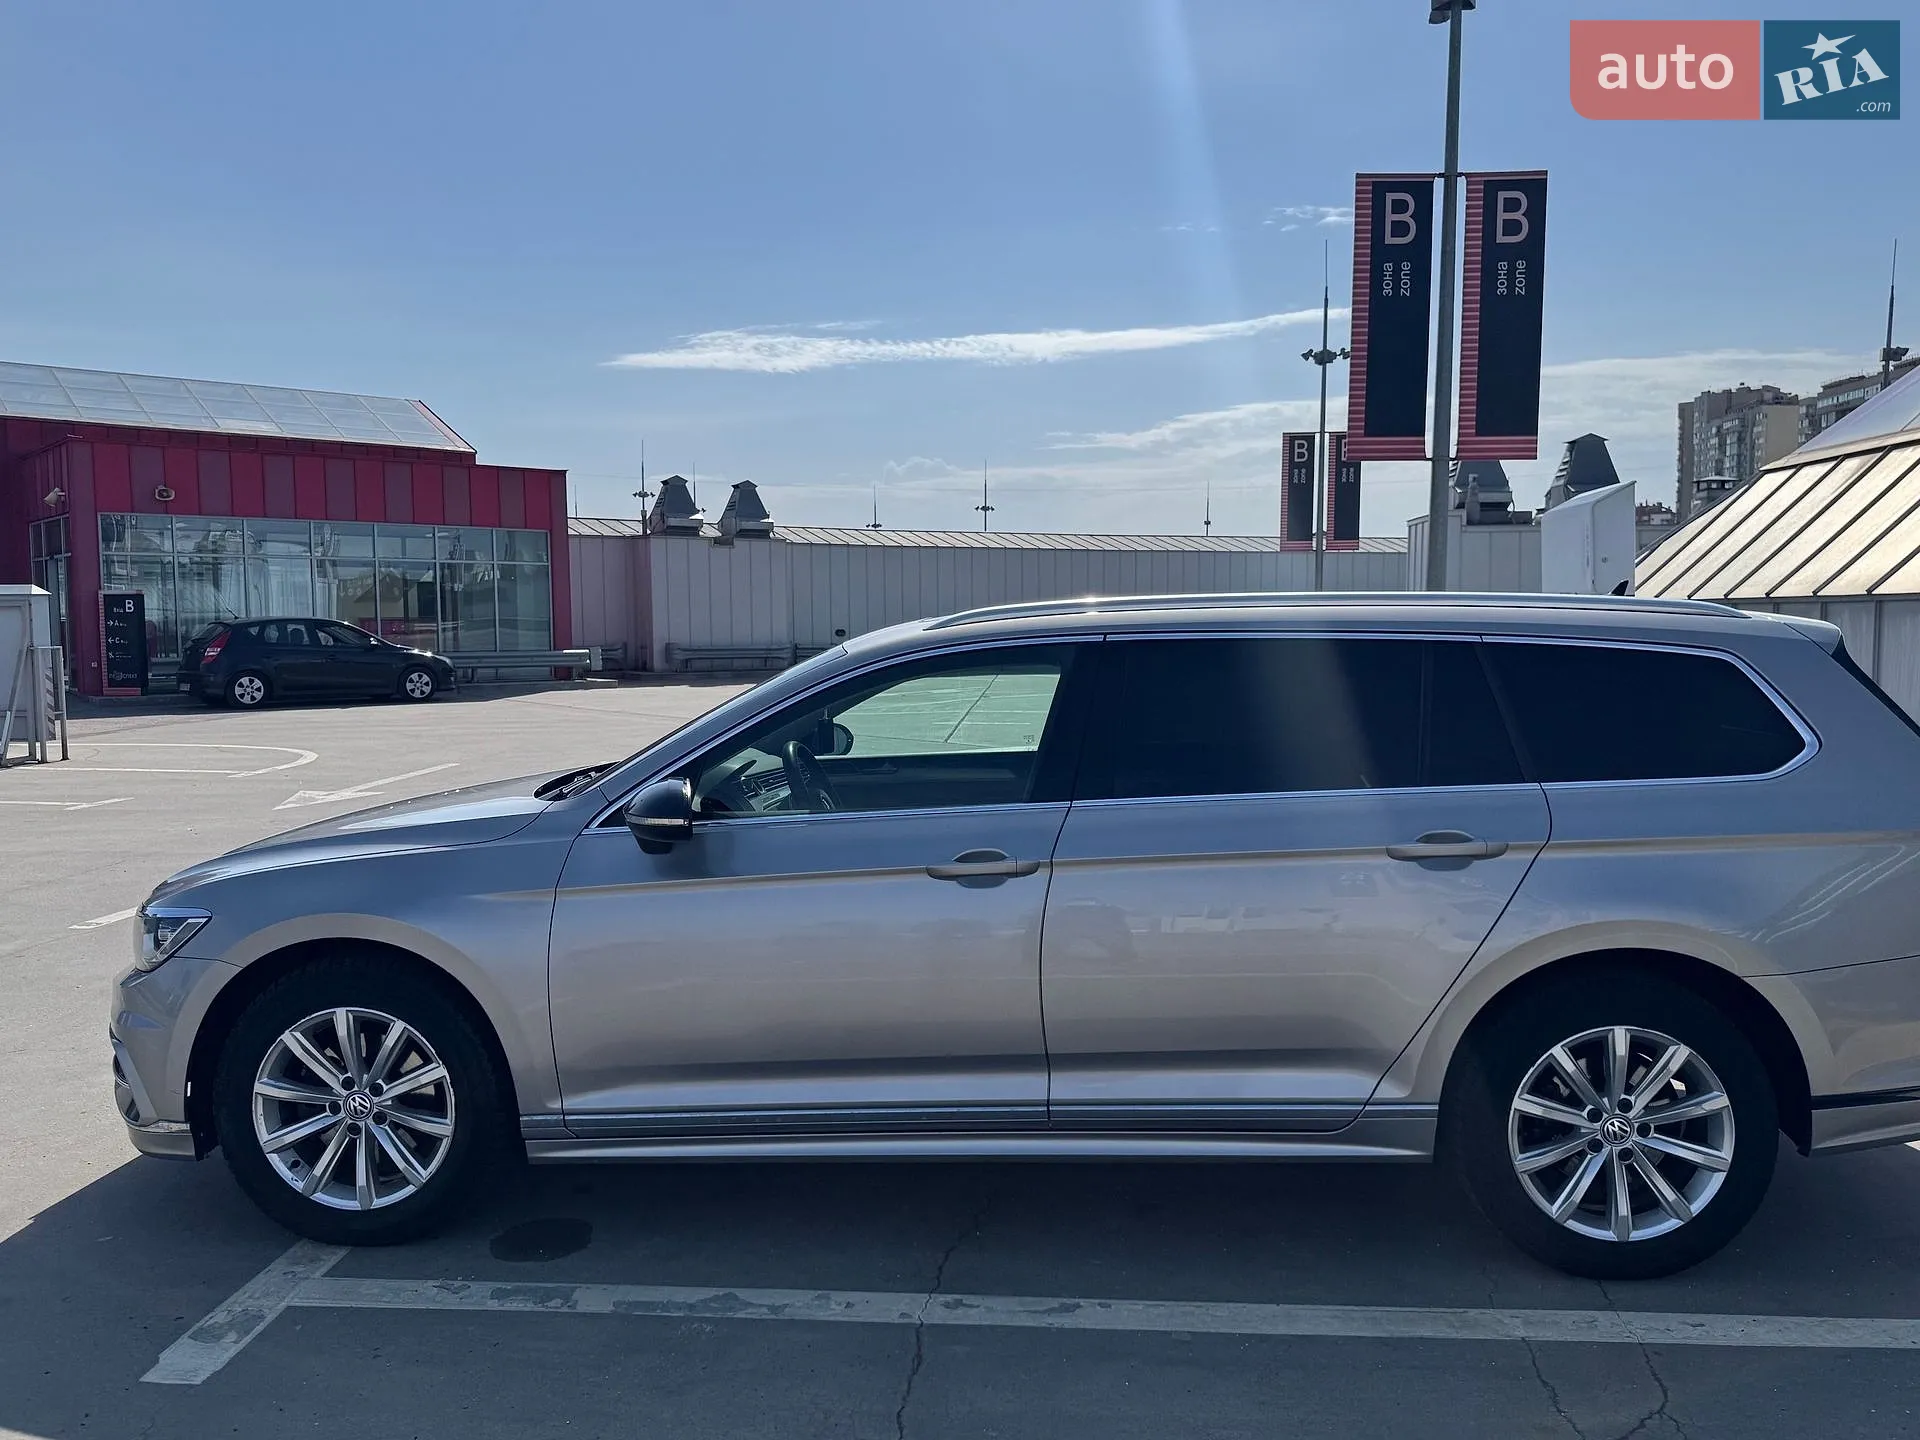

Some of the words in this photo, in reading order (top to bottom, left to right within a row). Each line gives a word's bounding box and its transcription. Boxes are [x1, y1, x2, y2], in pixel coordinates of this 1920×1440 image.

[1384, 191, 1417, 245] B
[1496, 190, 1530, 244] B
[1383, 262, 1393, 297] зона
[1400, 261, 1411, 297] zone
[1497, 261, 1508, 296] зона
[1515, 260, 1526, 295] zone
[1294, 440, 1308, 461] B
[125, 599, 135, 613] B
